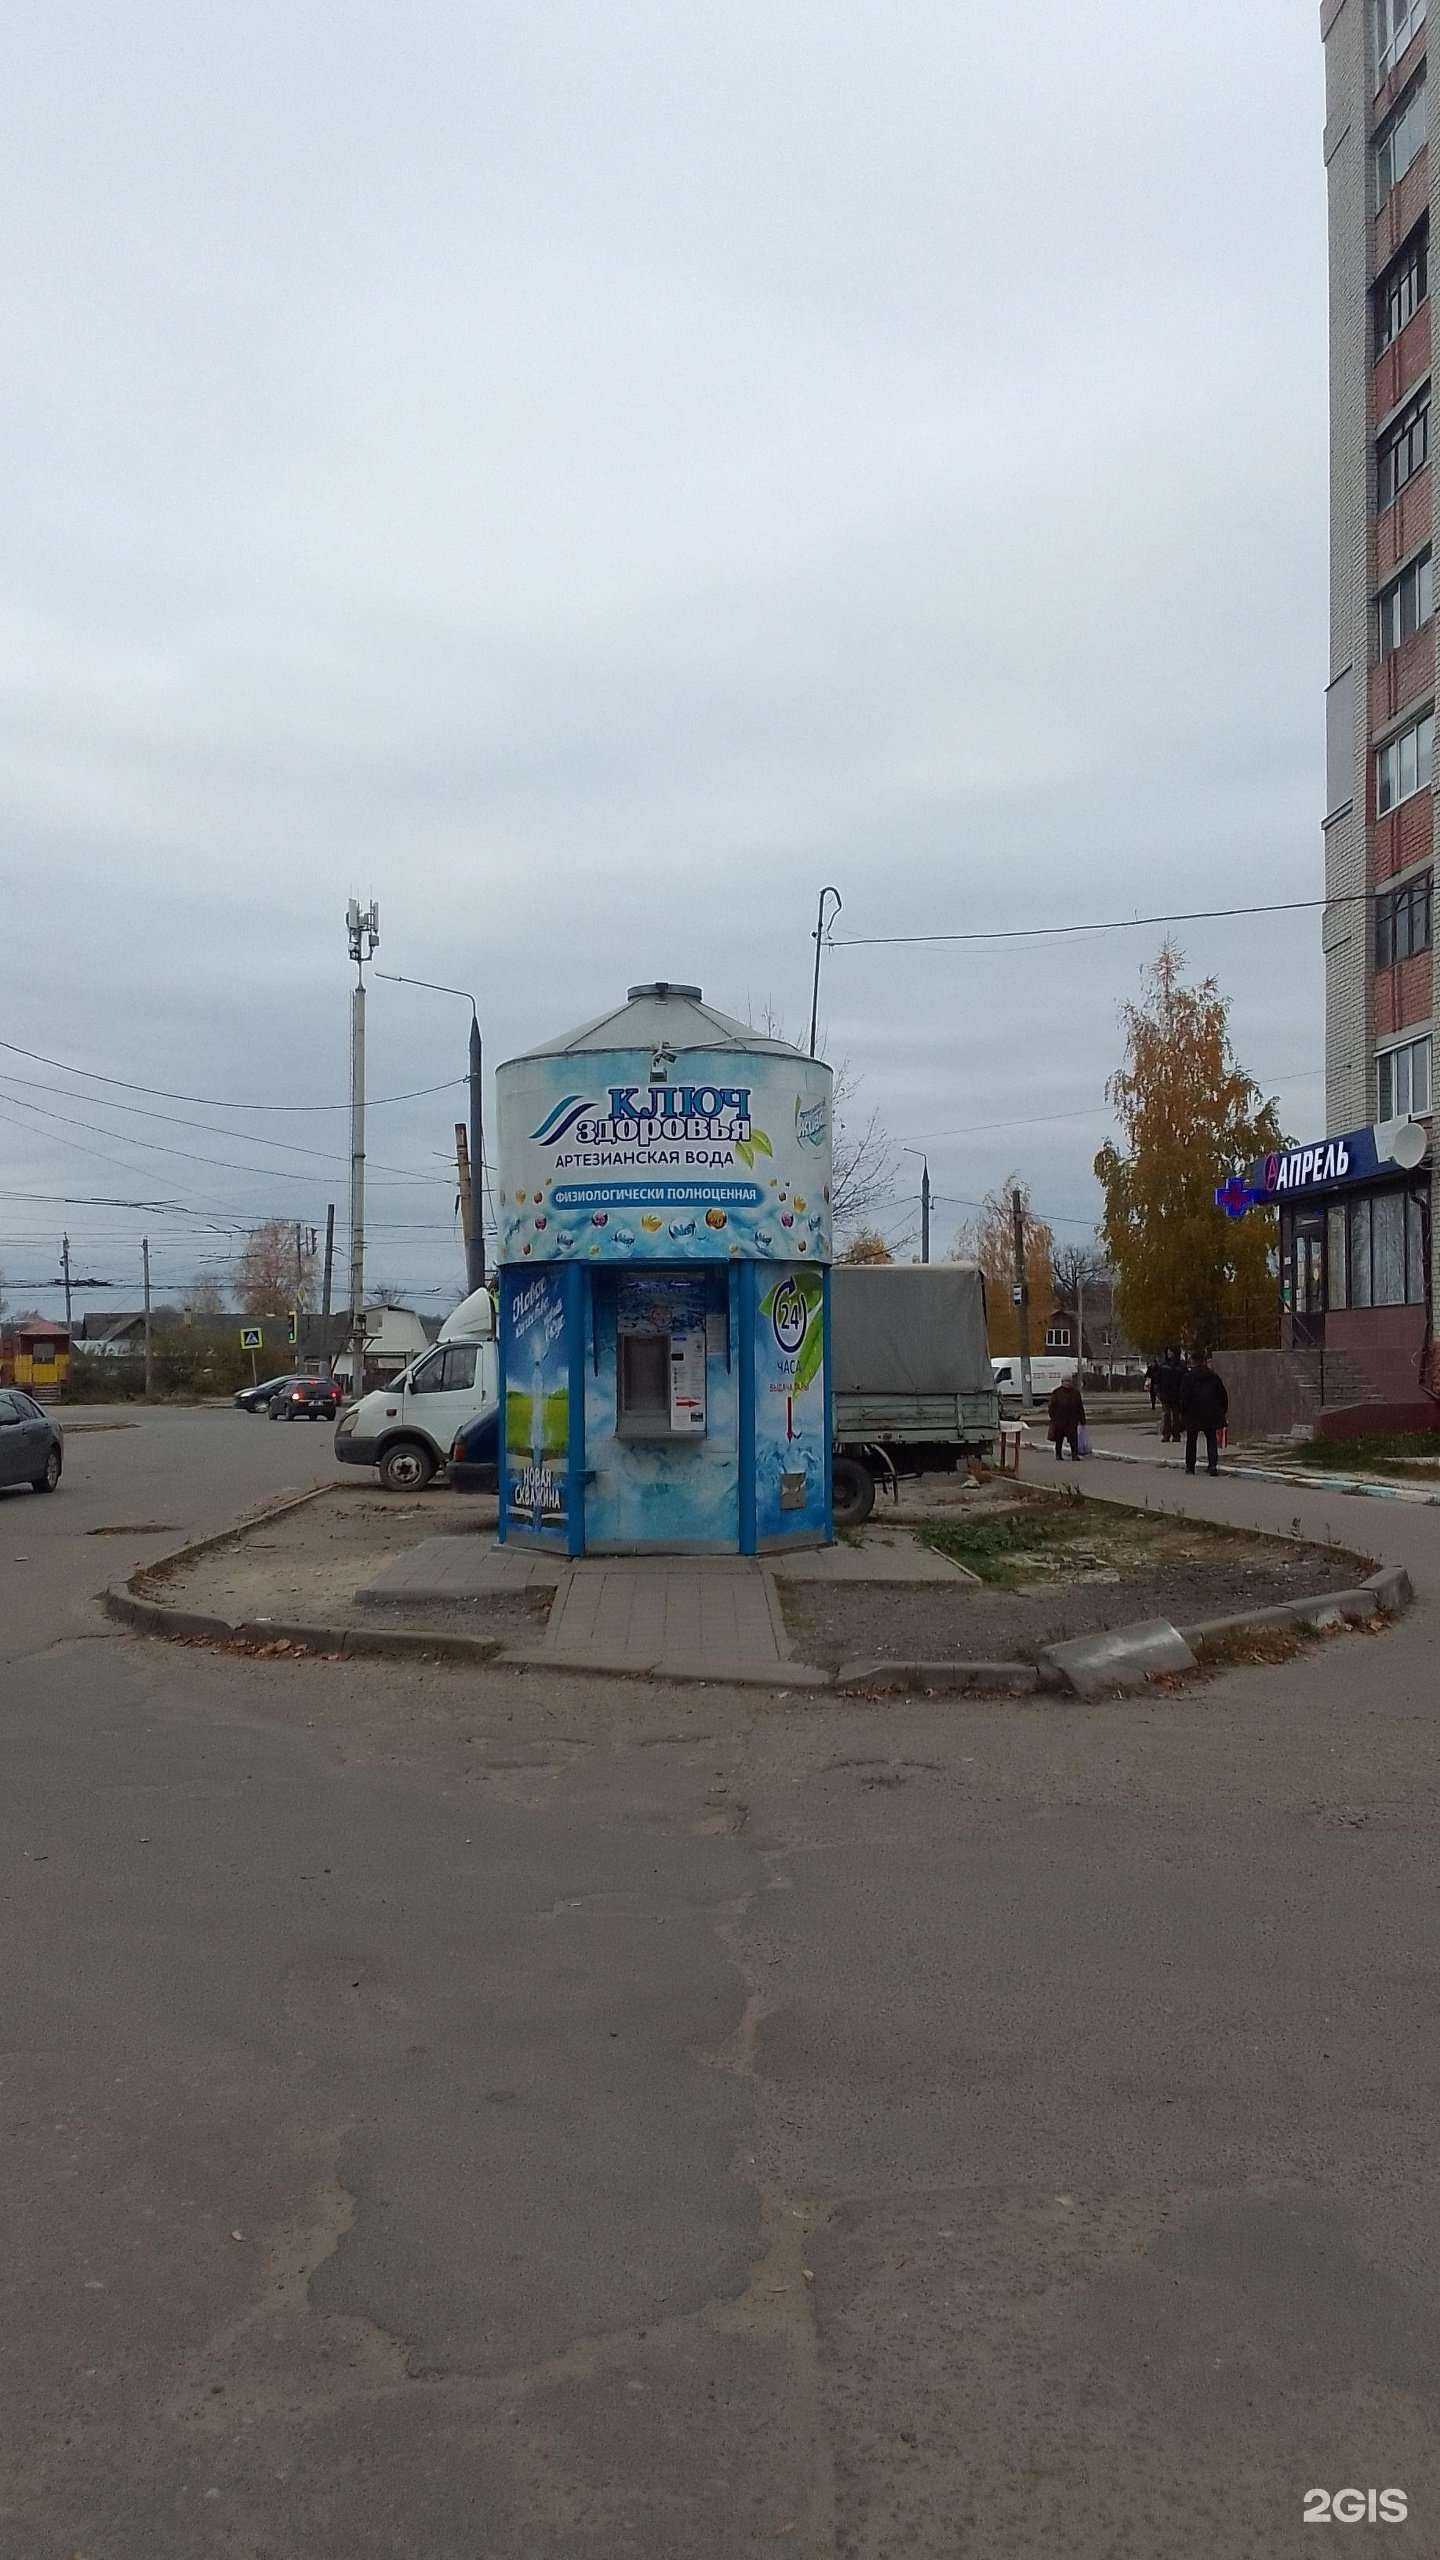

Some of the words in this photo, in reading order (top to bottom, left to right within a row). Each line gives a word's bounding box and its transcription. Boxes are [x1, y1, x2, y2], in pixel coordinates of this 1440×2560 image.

[608, 1087, 751, 1120] КЛЮЧ
[555, 1151, 680, 1169] АРТЕЗИАНСКАЯ
[685, 1151, 734, 1168] ВОДА
[1276, 1141, 1349, 1190] АПРЕЛЬ
[555, 1188, 664, 1203] ФИЗИОЛОГИЧЕСКИ
[667, 1188, 756, 1202] ПОЛНОЦЕННАЯ
[781, 1303, 800, 1330] 24
[777, 1360, 802, 1375] ЧАСА
[523, 1466, 552, 1487] НОВАЯ
[515, 1484, 561, 1509] СКВАЖИНА
